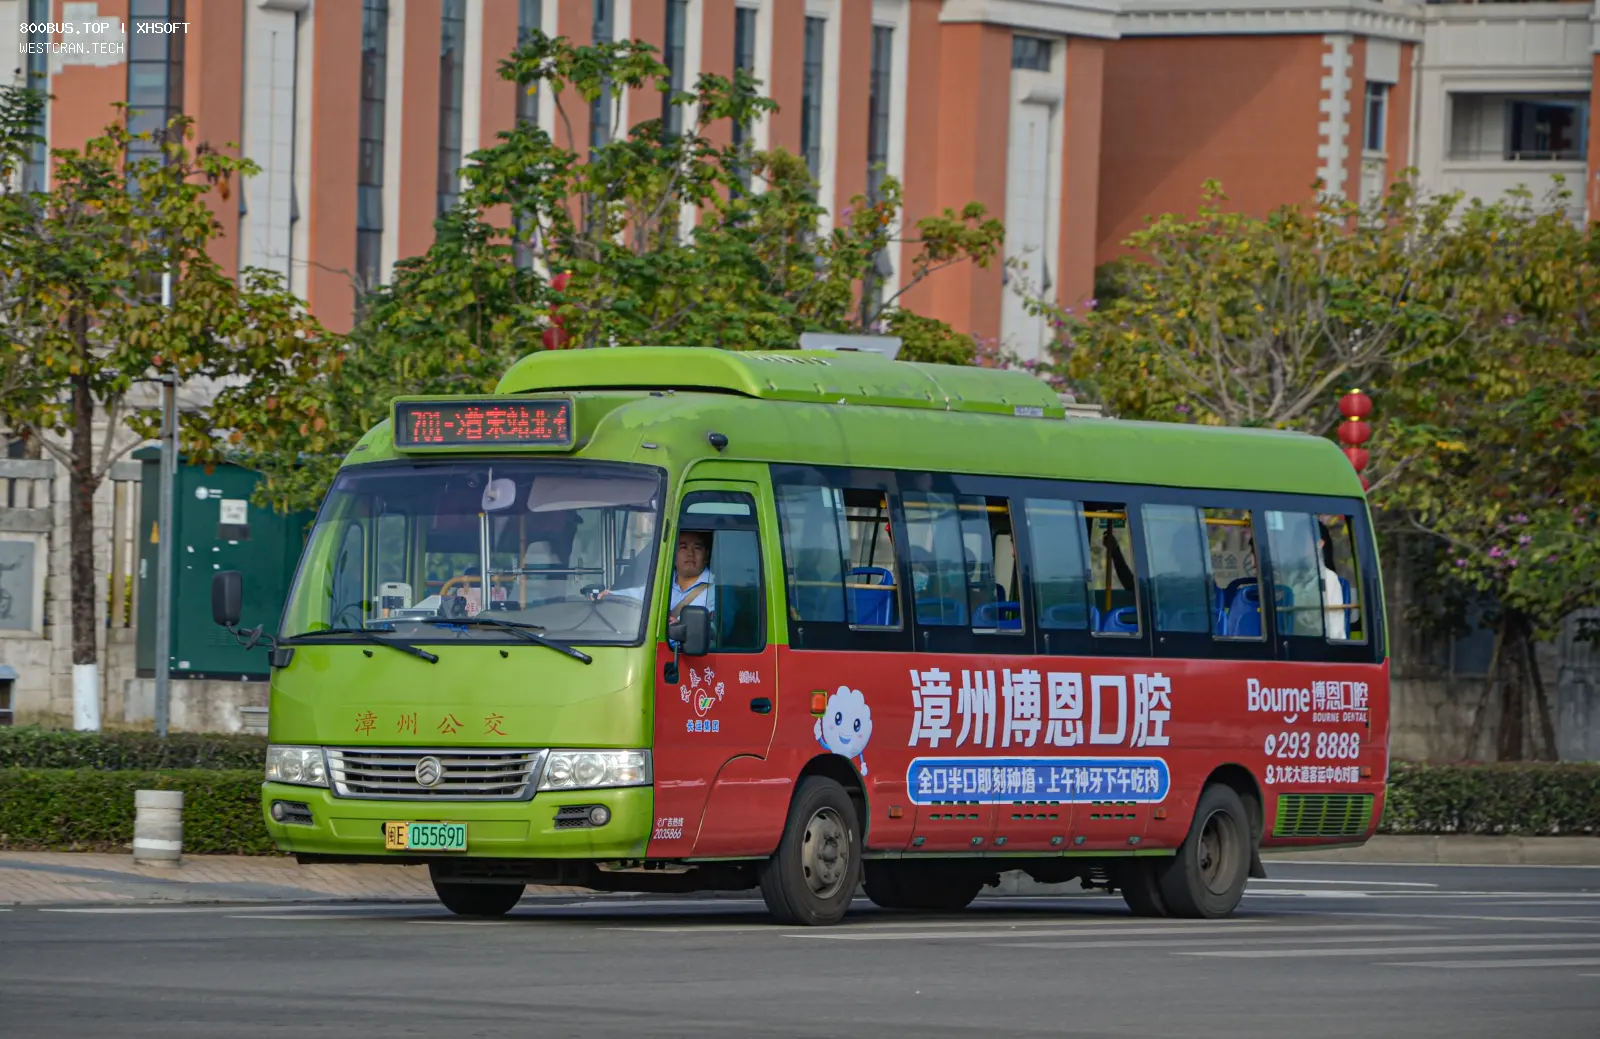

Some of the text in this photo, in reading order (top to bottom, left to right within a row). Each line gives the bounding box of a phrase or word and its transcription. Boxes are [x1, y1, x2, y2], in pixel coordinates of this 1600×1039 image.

[1247, 678, 1369, 712] Bourne 博恩口腔
[908, 667, 1172, 748] 漳州博恩口腔
[1312, 712, 1367, 722] BOURNE DENTAL
[354, 710, 508, 737] 漳州公交
[686, 718, 720, 733] 长运集团
[1276, 731, 1360, 759] 293 8888
[1275, 765, 1359, 783] 九龙大道客运中心对面
[653, 827, 682, 840] 2035866
